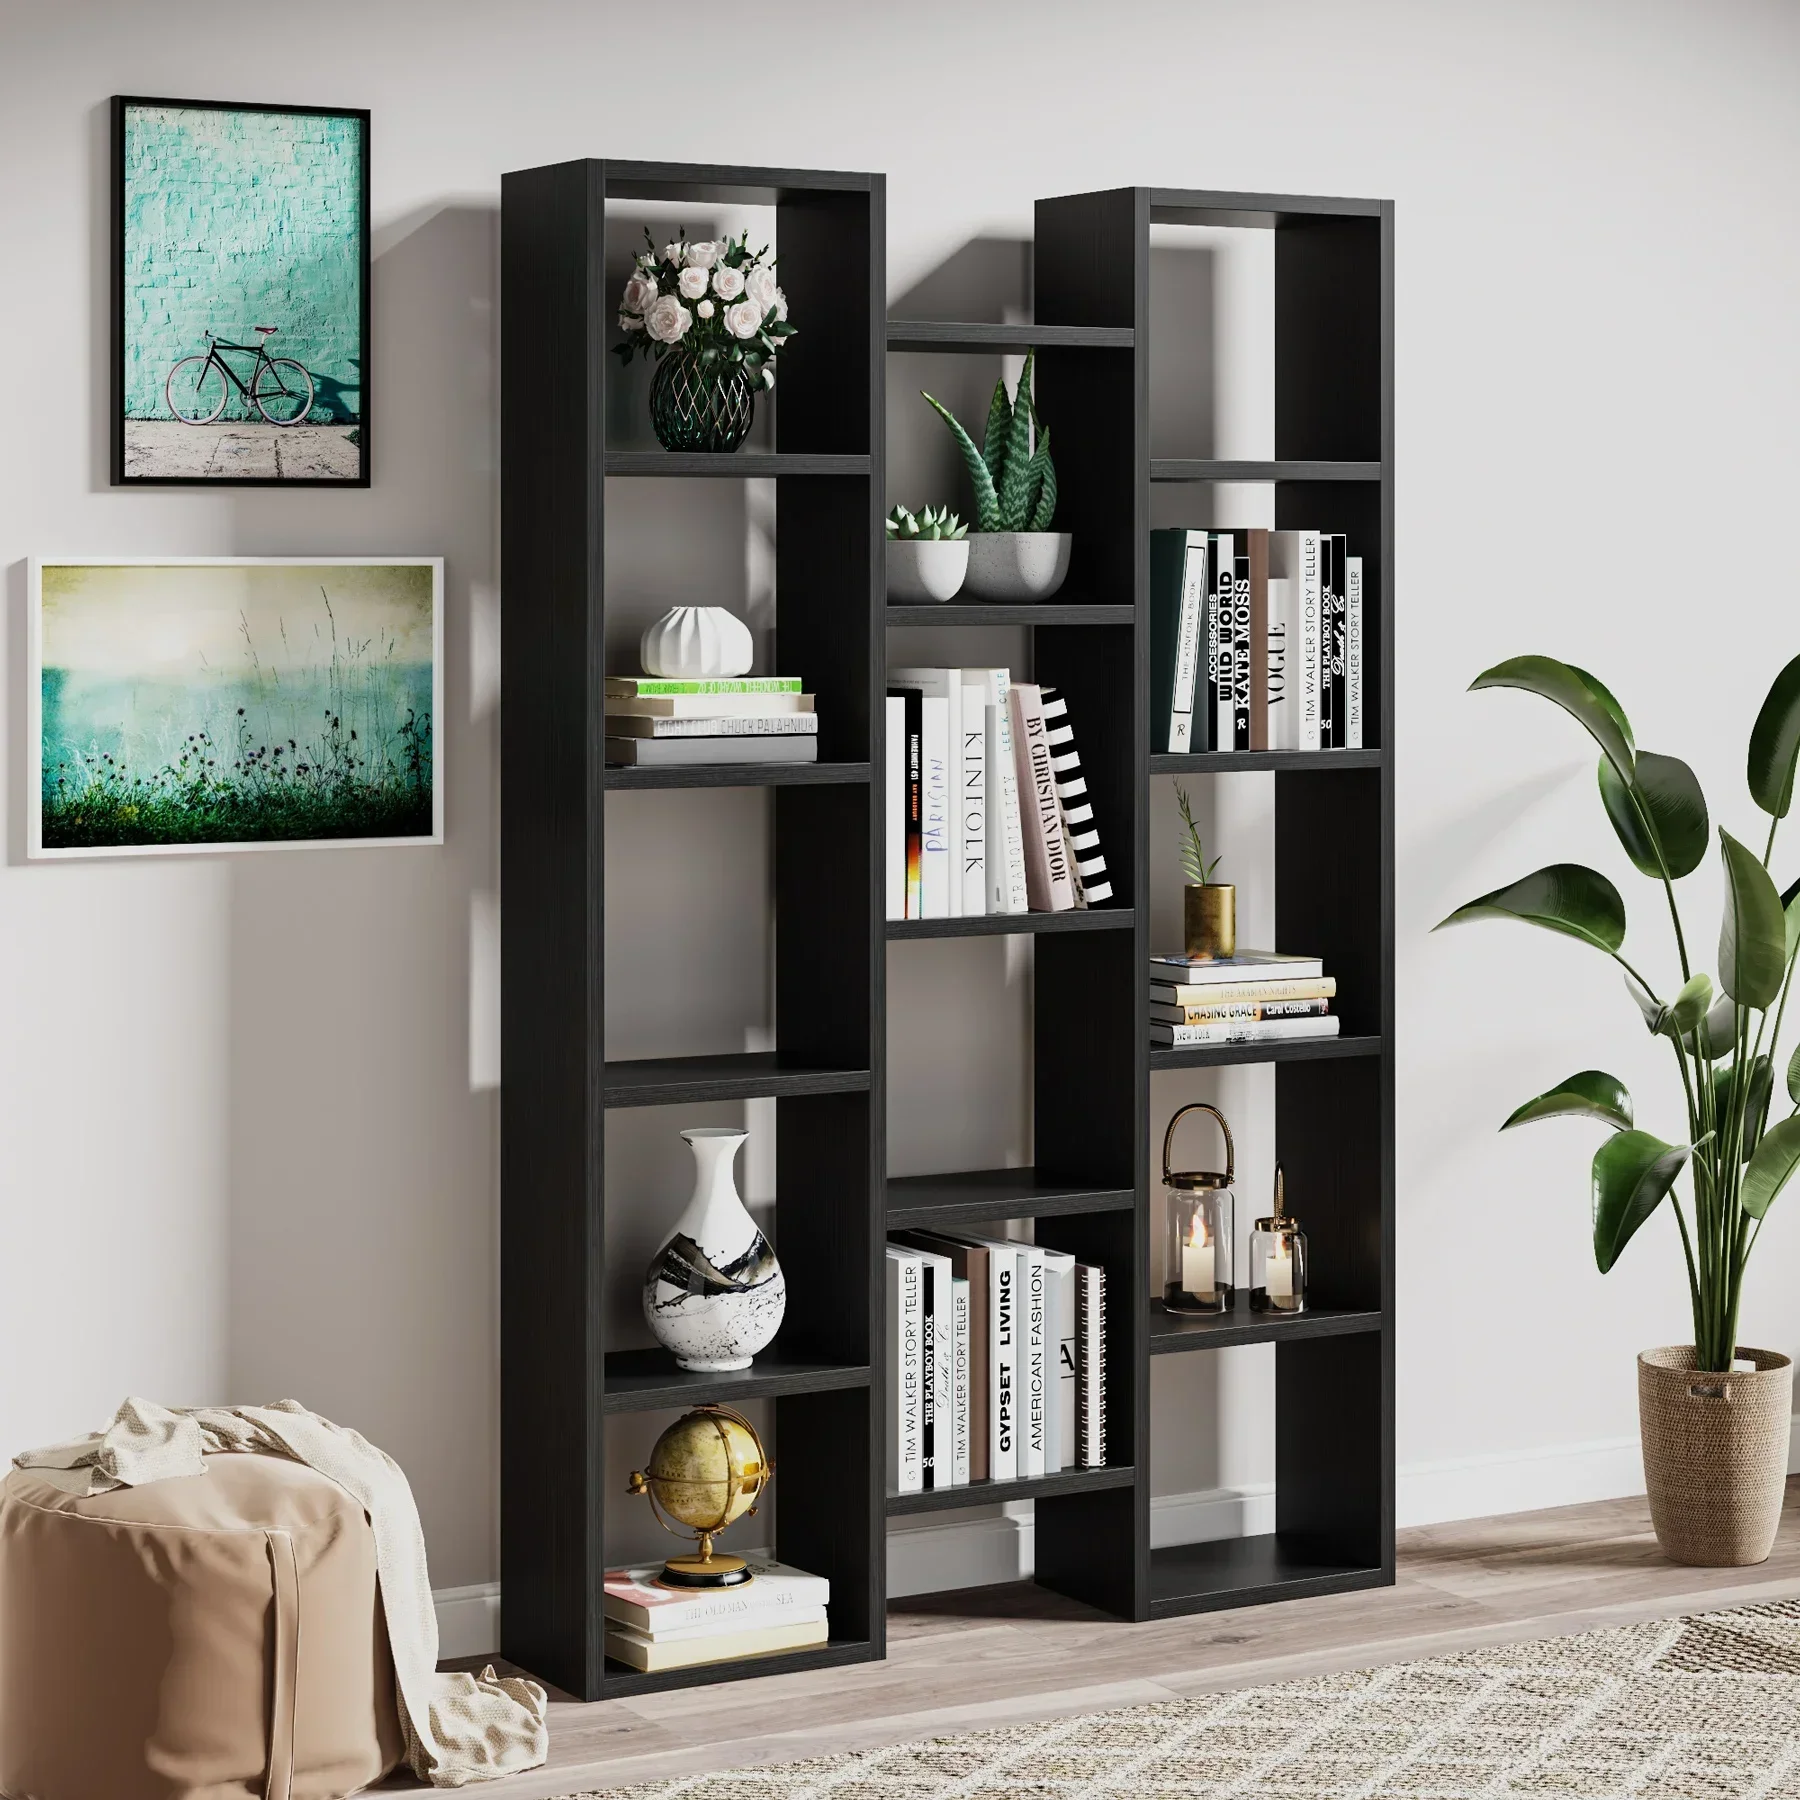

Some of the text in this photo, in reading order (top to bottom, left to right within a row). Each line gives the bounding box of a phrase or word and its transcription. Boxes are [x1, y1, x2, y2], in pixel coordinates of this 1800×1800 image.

[1182, 580, 1196, 680] THE KINFOLK BOOK
[1209, 594, 1217, 683] ACCESSORIES
[1219, 572, 1232, 701] WILD WORLD
[1235, 579, 1250, 710] KATE MOSS
[1268, 623, 1285, 705] VOGUE
[1305, 538, 1315, 722] TIM WALKER STORY TELLER
[1323, 616, 1331, 665] PLAYBOY
[1350, 571, 1359, 725] TIM WALKER STORY TELLER
[721, 719, 754, 733] CHUCK
[758, 718, 814, 733] PALAHNIUK
[997, 673, 1007, 704] COLE
[1238, 718, 1246, 729] R
[1321, 720, 1331, 729] 50
[910, 734, 919, 780] FAHRENHEIT 451
[1002, 732, 1010, 752] LEE
[922, 759, 948, 852] PARISIAN
[965, 732, 983, 873] KINFOLK
[1003, 776, 1024, 904] TRANQUILITY
[1027, 716, 1066, 883] BY CHRISTIAN DIOR
[1188, 1005, 1257, 1020] CHASING GRACE
[1266, 1003, 1311, 1014] Carol Costello
[905, 1266, 917, 1462] TIM WALKER STORY TELLER
[925, 1314, 934, 1425] THE PLAYBOY BOOK
[957, 1297, 966, 1460] TIM WALKER STORY TELLER
[999, 1270, 1011, 1452] GYPSET LIVING
[1031, 1265, 1042, 1451] AMERICAN FASHION
[923, 1457, 934, 1467] 50
